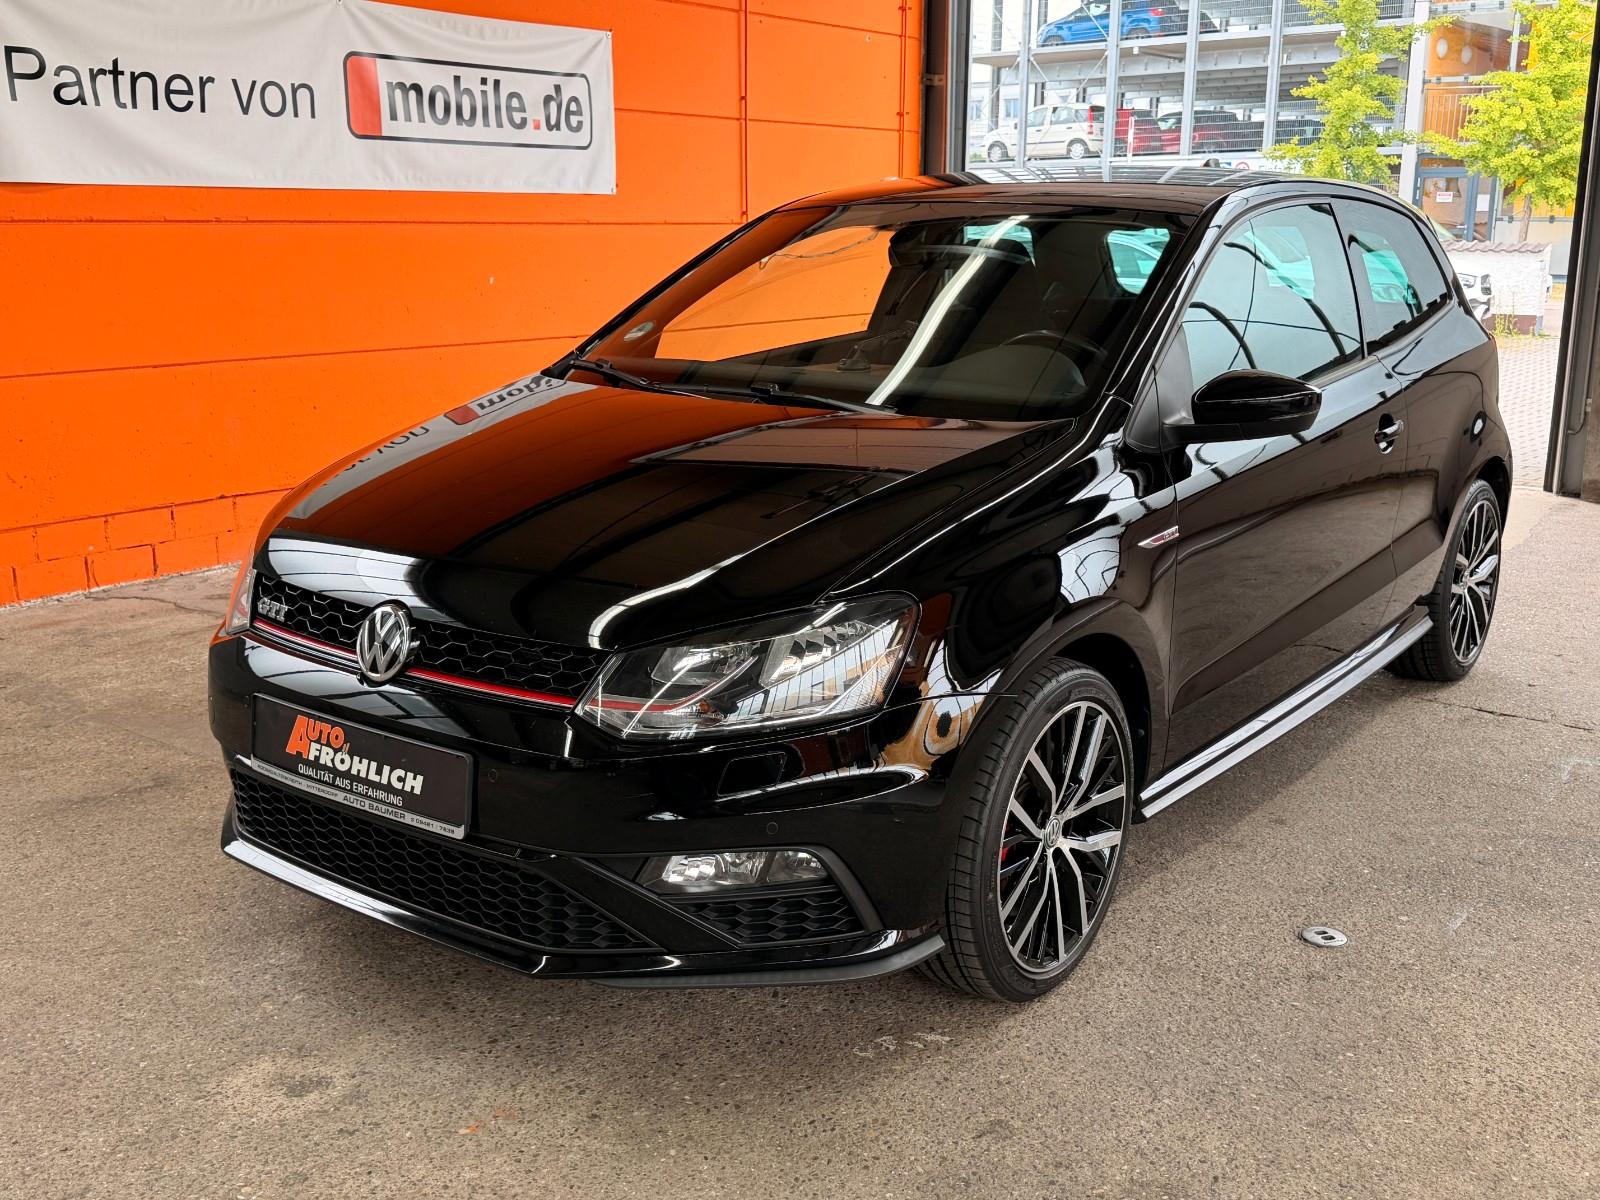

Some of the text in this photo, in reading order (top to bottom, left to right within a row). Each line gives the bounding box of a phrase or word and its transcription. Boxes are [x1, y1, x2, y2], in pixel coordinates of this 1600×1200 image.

[4, 45, 585, 133] Partner von mobile.de
[257, 597, 289, 622] GTI
[286, 714, 345, 759] AUTO
[298, 763, 334, 784] QUALITÄT
[335, 776, 351, 790] AUS
[352, 782, 403, 807] ERFAHRUNG
[308, 742, 424, 795] FRÖHLICH
[343, 795, 366, 808] AUTO
[368, 802, 406, 820] BAUMER
